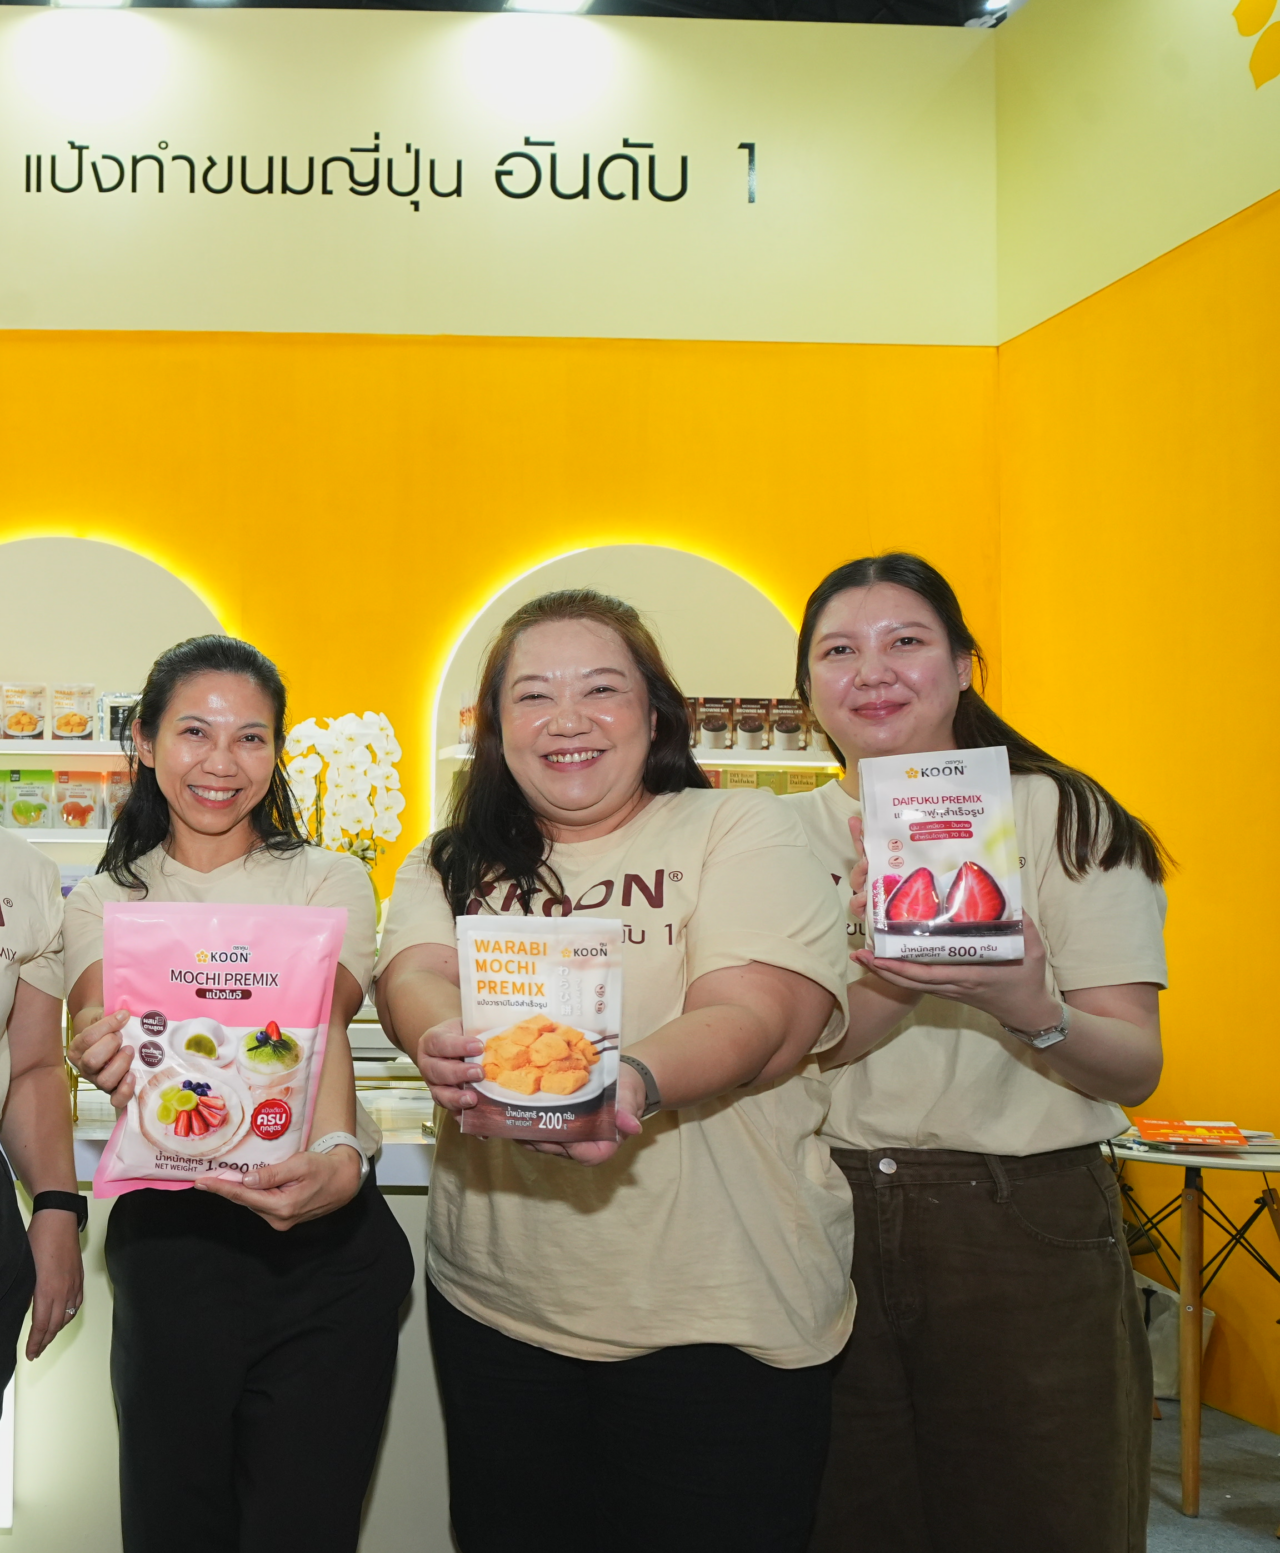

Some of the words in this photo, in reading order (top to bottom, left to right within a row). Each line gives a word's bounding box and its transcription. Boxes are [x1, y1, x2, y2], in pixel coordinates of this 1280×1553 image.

[24, 131, 463, 212] แป้งทำขนมญี่ปุ่น
[495, 136, 689, 202] อันดับ
[737, 142, 756, 204] 1
[920, 765, 965, 778] KOON
[892, 796, 939, 807] DAIFUKU
[941, 794, 983, 805] PREMIX
[664, 923, 673, 945] 1
[474, 938, 548, 957] WARABI
[573, 947, 608, 957] KOON
[900, 943, 946, 955] น้ำหนักสุทธิ
[948, 946, 977, 958] 800
[980, 943, 998, 952] กรัม
[210, 951, 249, 963] KOON
[474, 958, 537, 976] MOCHI
[170, 969, 221, 986] MOCHI
[224, 972, 279, 987] PREMIX
[206, 989, 242, 999] แป้งโมจิ
[476, 979, 546, 997] PREMIX
[257, 1113, 287, 1125] ครบ
[505, 1106, 537, 1120] น้ำหนักสุทธิ
[538, 1111, 563, 1130] 200
[563, 1111, 575, 1120] กรัม
[155, 1151, 204, 1167] น้ำหนักสุทธิ
[154, 1162, 169, 1170] NET
[170, 1164, 198, 1173] WEIGHT
